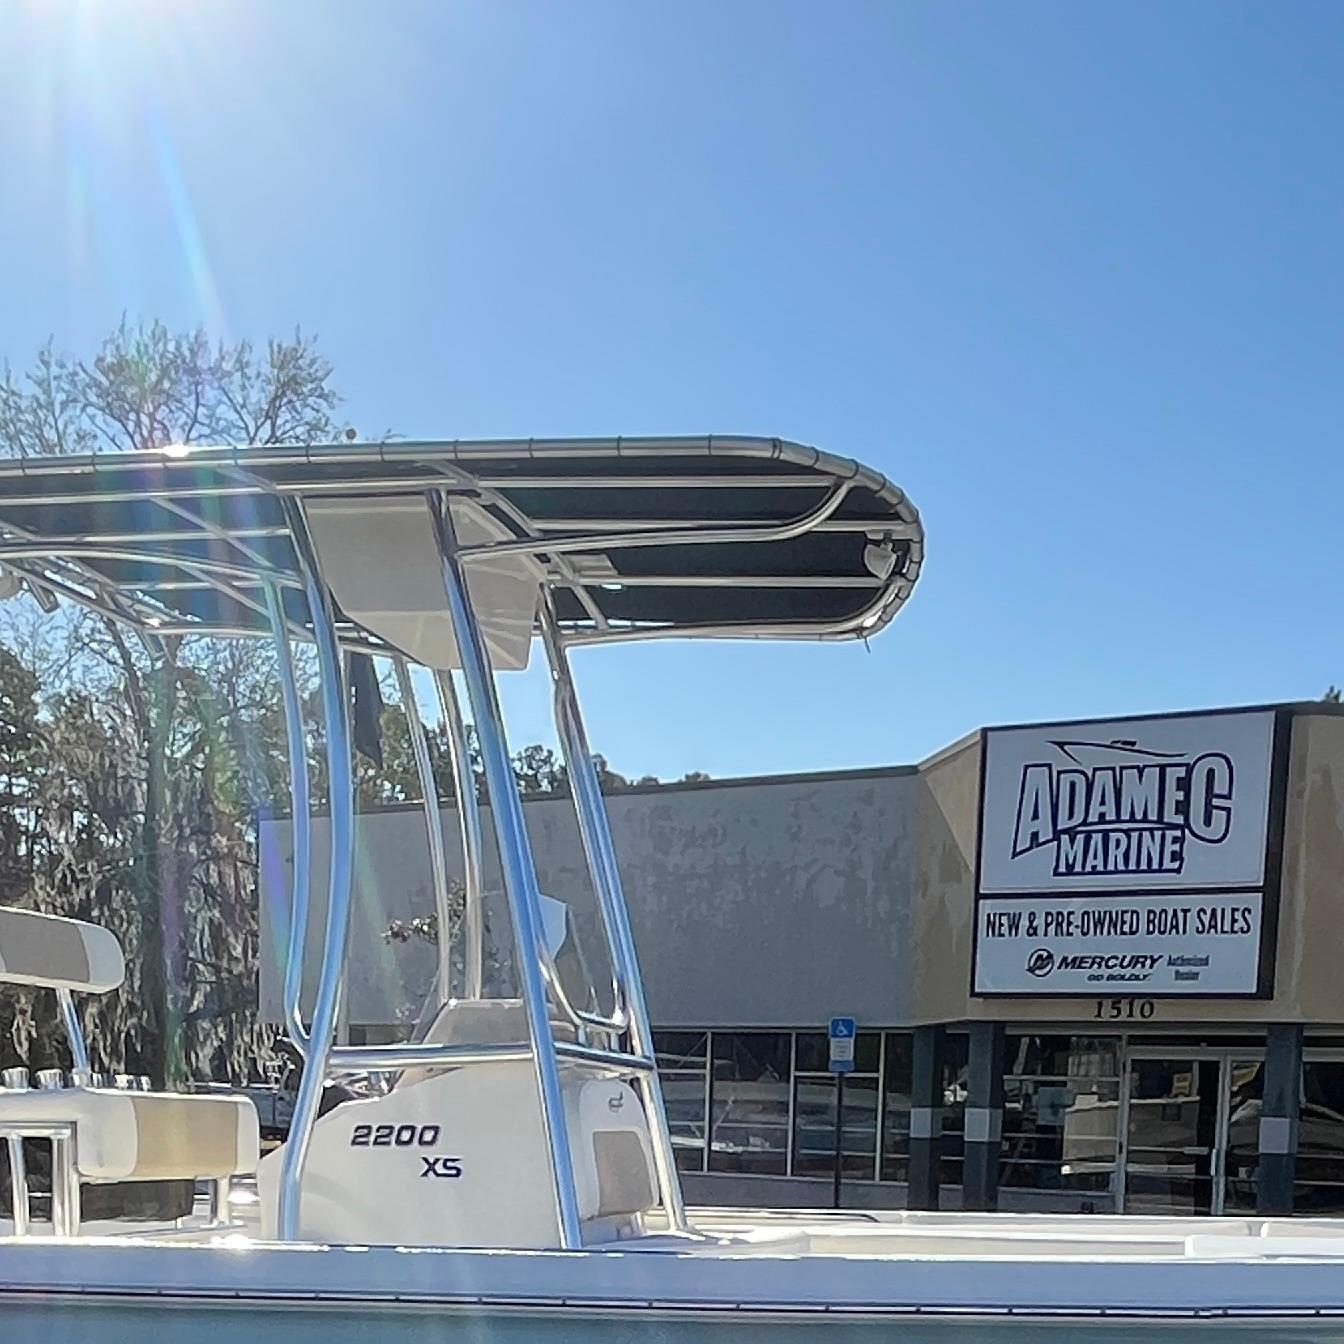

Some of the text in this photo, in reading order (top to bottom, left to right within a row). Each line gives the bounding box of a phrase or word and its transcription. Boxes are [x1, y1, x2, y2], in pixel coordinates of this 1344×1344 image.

[1011, 752, 1233, 860] ADAMEC
[1053, 828, 1186, 877] MARINE
[986, 906, 1252, 938] NEW & PRE-OWNED BOAT SALES
[1056, 954, 1164, 970] MERCURY
[1094, 1000, 1155, 1019] 1510
[350, 1124, 441, 1147] 2200
[420, 1156, 463, 1178] XS
